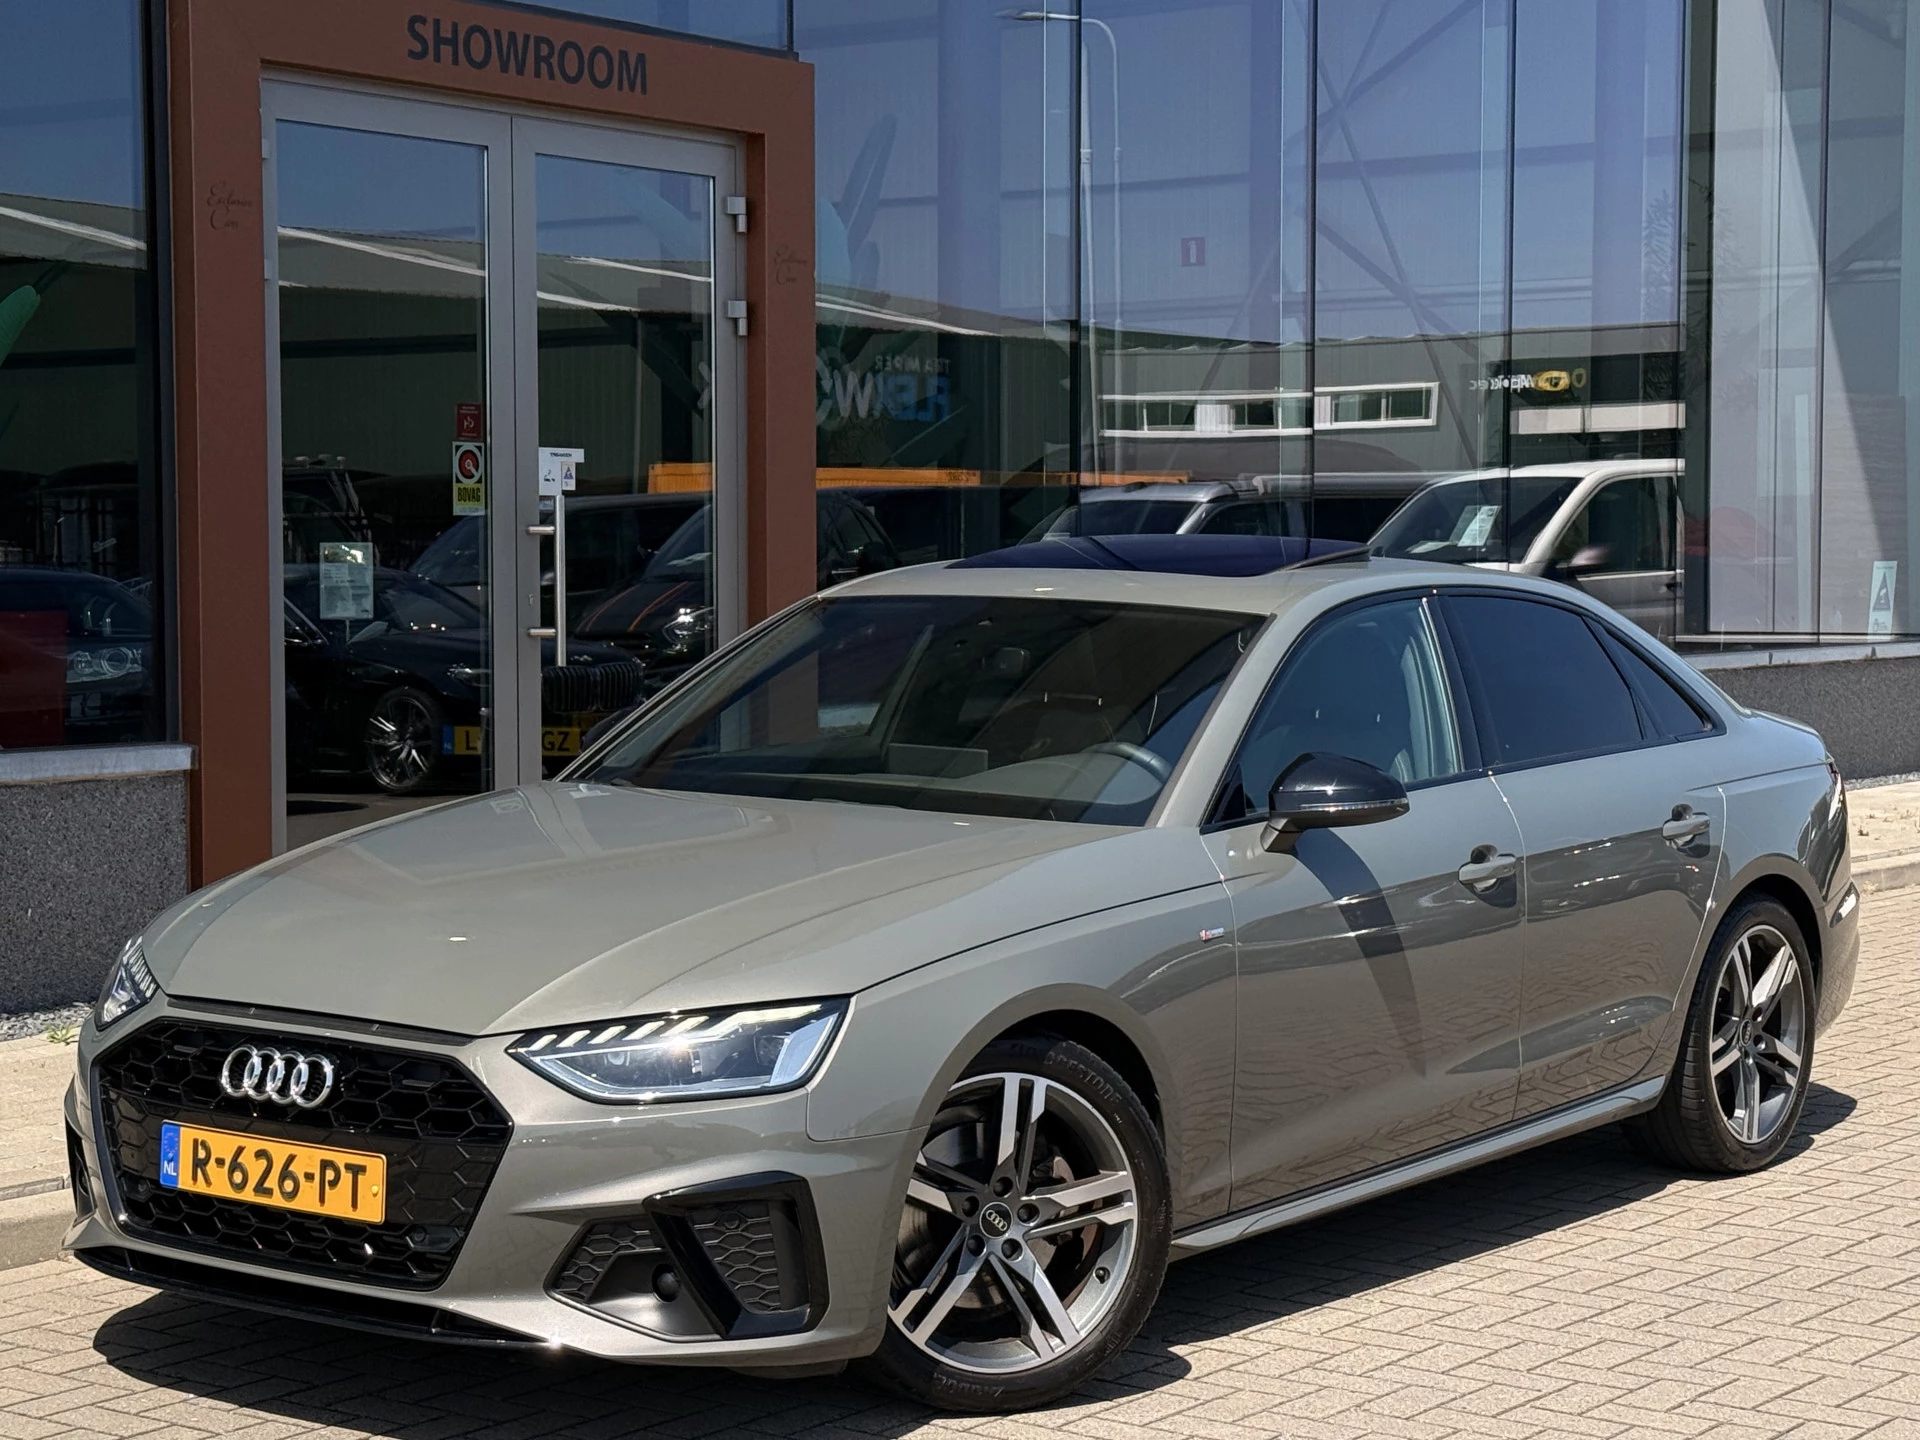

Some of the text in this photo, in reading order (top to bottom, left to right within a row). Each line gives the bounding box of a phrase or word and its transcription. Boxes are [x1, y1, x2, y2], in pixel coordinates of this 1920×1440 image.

[406, 14, 648, 95] SHOWROOM
[457, 487, 481, 503] BOVAG
[163, 1160, 177, 1176] NL
[191, 1137, 368, 1212] R-626-PT
